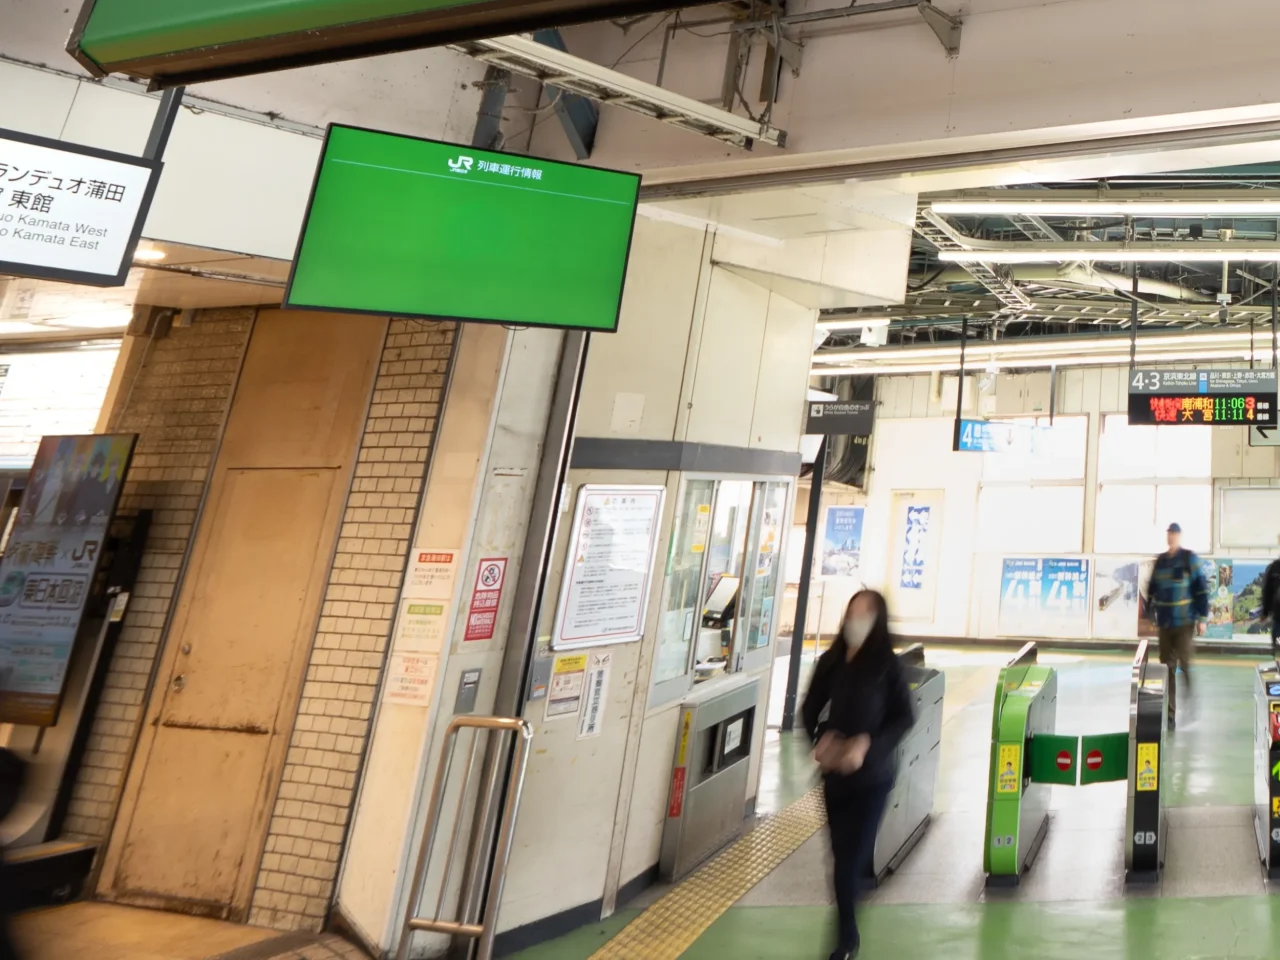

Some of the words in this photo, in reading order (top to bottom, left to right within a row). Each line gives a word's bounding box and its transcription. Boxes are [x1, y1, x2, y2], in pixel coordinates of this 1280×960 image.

[448, 156, 473, 170] JR
[477, 160, 543, 180] 列車運行情報
[8, 189, 54, 214] 東館
[18, 213, 70, 232] Kamata
[75, 222, 108, 238] West
[12, 227, 65, 246] Kamata
[70, 236, 99, 251] East
[1181, 397, 1214, 410] 南浦和
[1215, 397, 1245, 409] 11:06
[1245, 396, 1255, 409] 3
[1215, 409, 1243, 421] 11:11
[1246, 409, 1254, 421] 4
[962, 424, 973, 448] 4
[71, 540, 99, 561] JR
